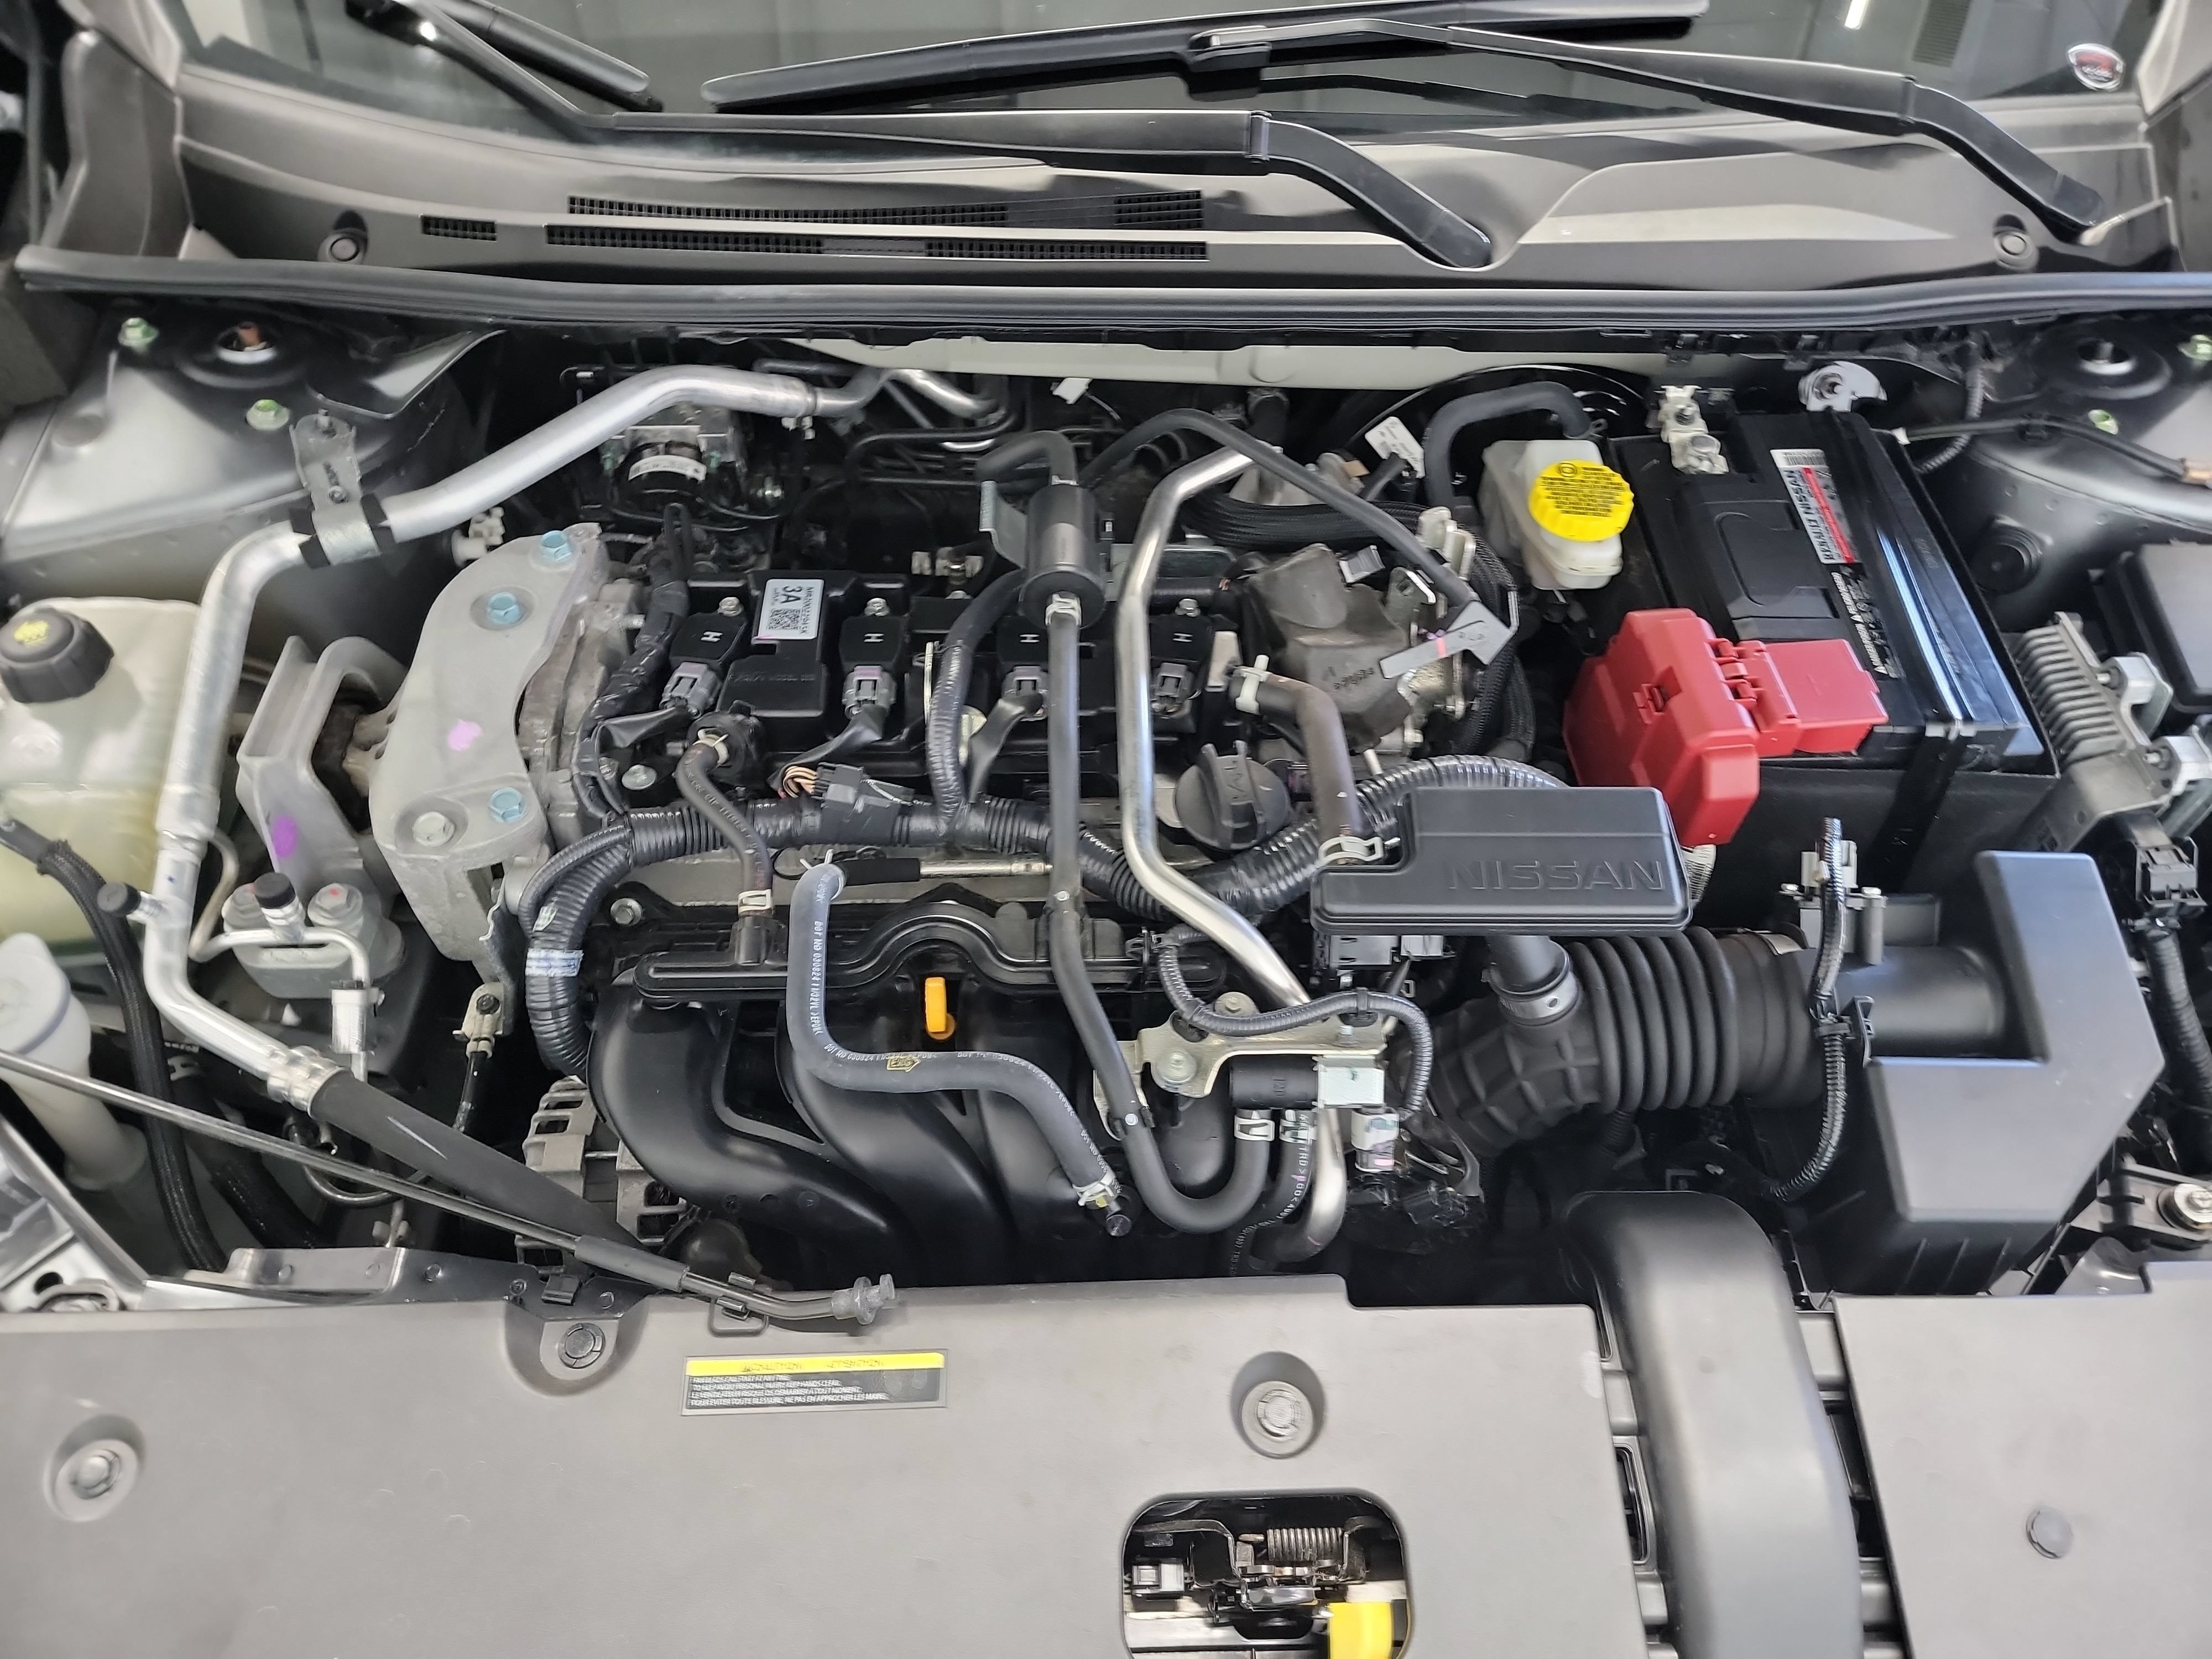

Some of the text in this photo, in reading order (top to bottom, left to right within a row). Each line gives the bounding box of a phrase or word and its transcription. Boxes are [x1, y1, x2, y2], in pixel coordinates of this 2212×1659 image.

[1783, 470, 1811, 515] NISSAN
[782, 586, 801, 604] 3A
[1448, 860, 1665, 891] NISSAN
[1298, 1146, 1309, 1166] TRD
